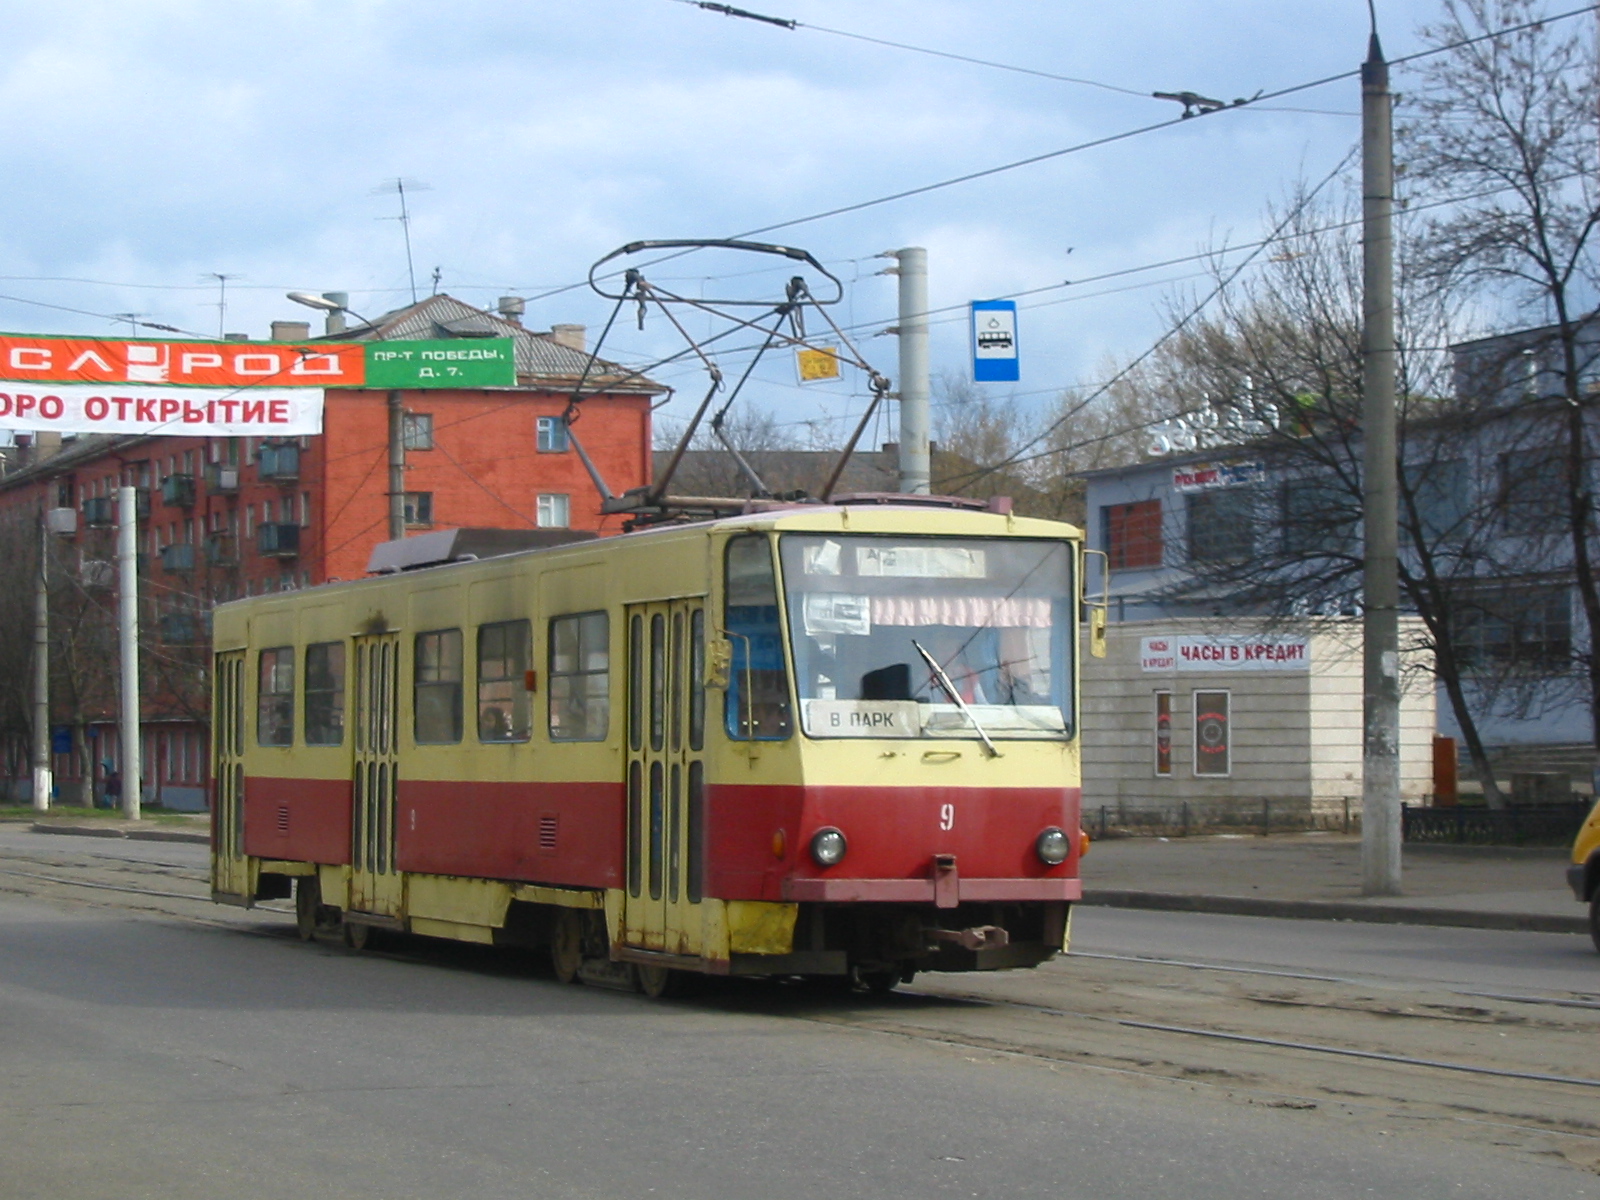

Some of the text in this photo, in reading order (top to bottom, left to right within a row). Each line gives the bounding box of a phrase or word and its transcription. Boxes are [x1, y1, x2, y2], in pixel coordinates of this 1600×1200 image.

[374, 350, 505, 361] ПР-Т ПОБЕДЫ,
[418, 367, 464, 378] Д. 7.
[84, 396, 289, 423] ОТКРЫТИЕ
[1180, 644, 1305, 662] ЧАСЫ В КРЕДИТ
[830, 712, 894, 727] В ПАРК
[940, 803, 955, 831] 9
